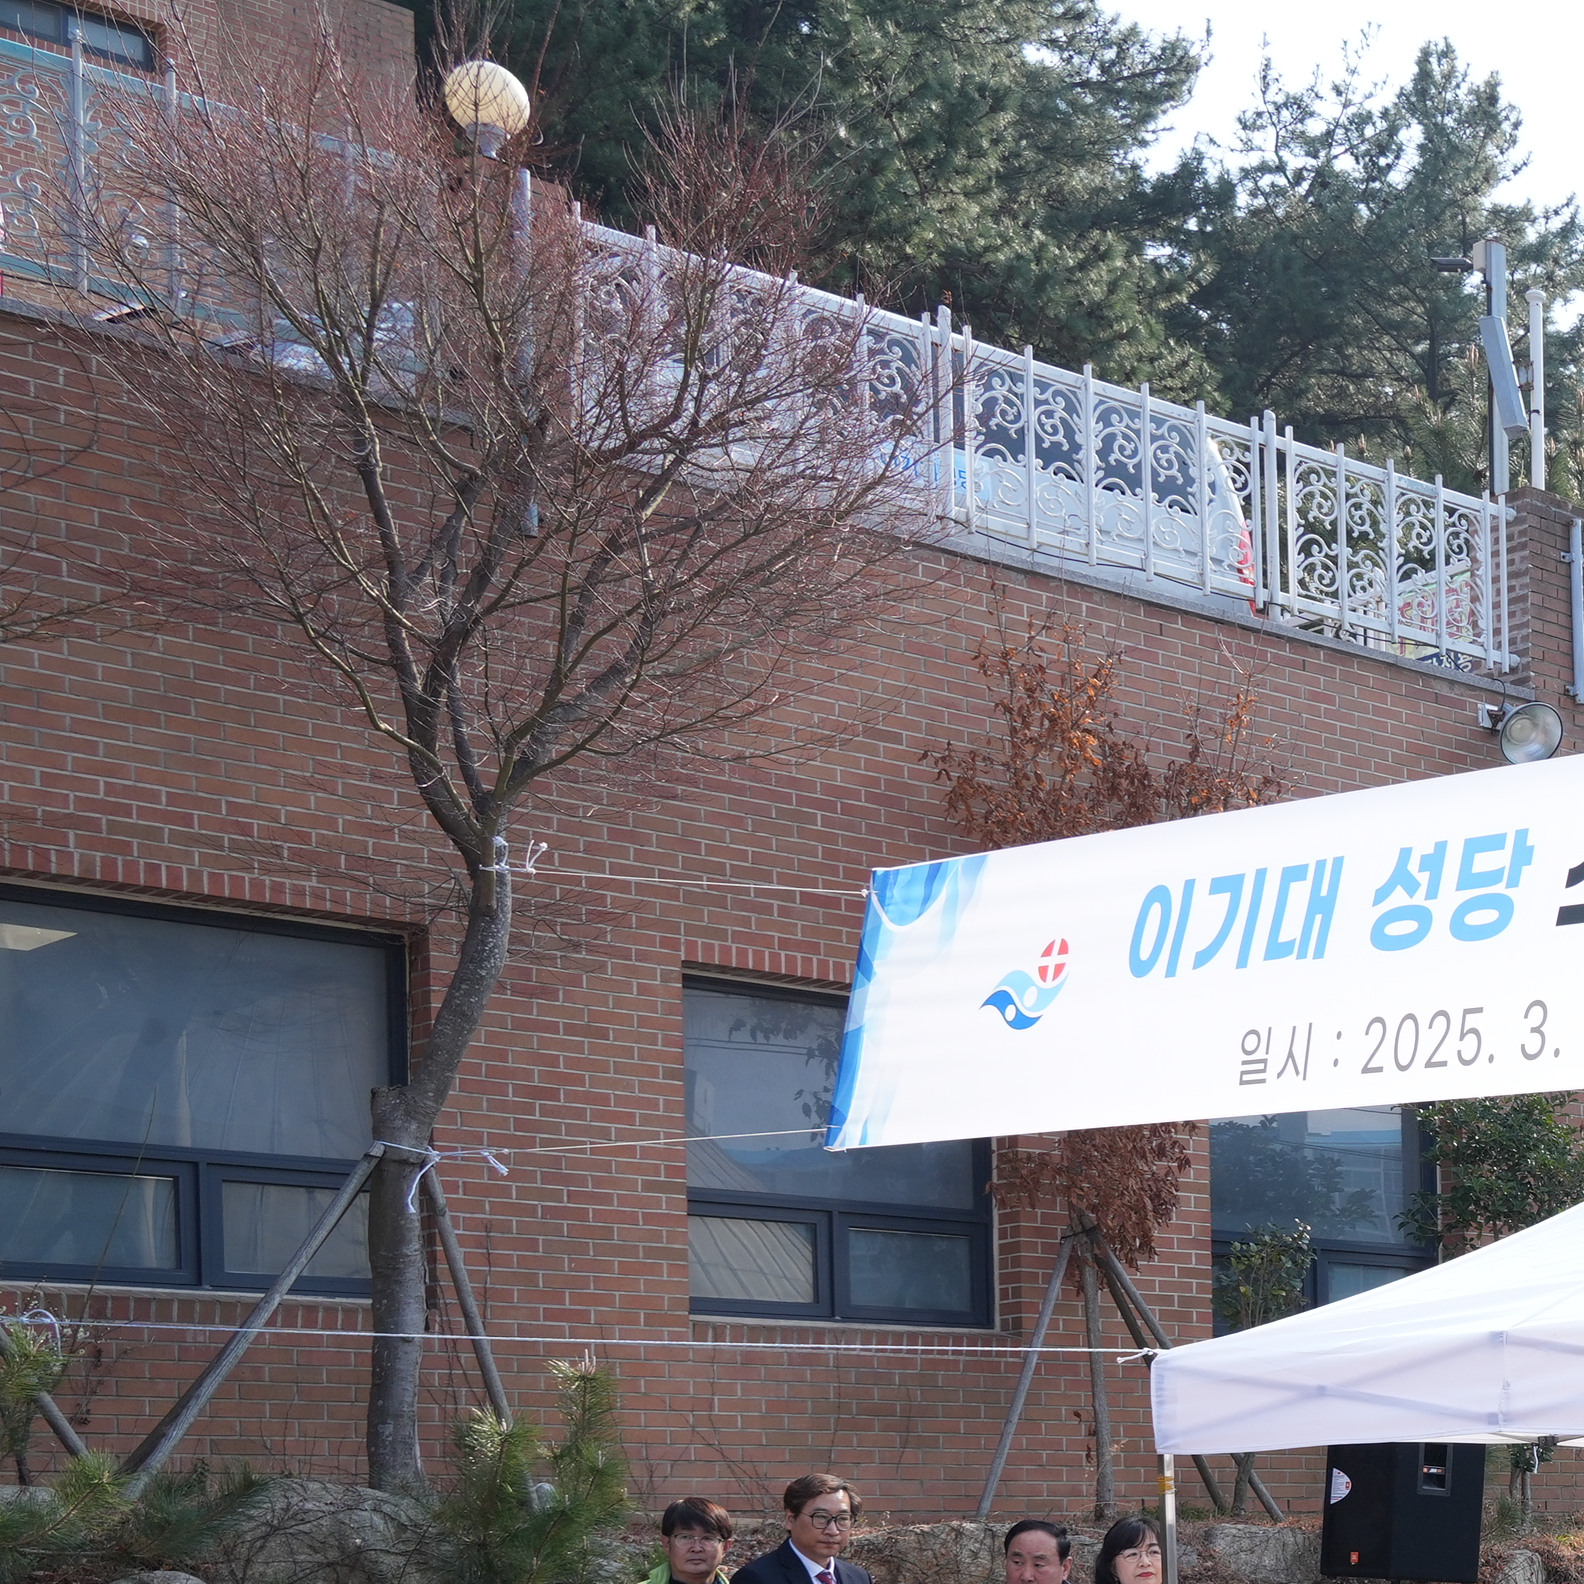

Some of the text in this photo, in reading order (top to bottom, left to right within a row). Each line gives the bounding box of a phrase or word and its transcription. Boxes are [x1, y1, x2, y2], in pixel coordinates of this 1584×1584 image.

[1129, 856, 1344, 978] 이기대
[1370, 828, 1534, 951] 성당
[1239, 1023, 1312, 1085] 일시
[1361, 1007, 1494, 1074] 2025.
[1521, 1000, 1560, 1060] 3.
